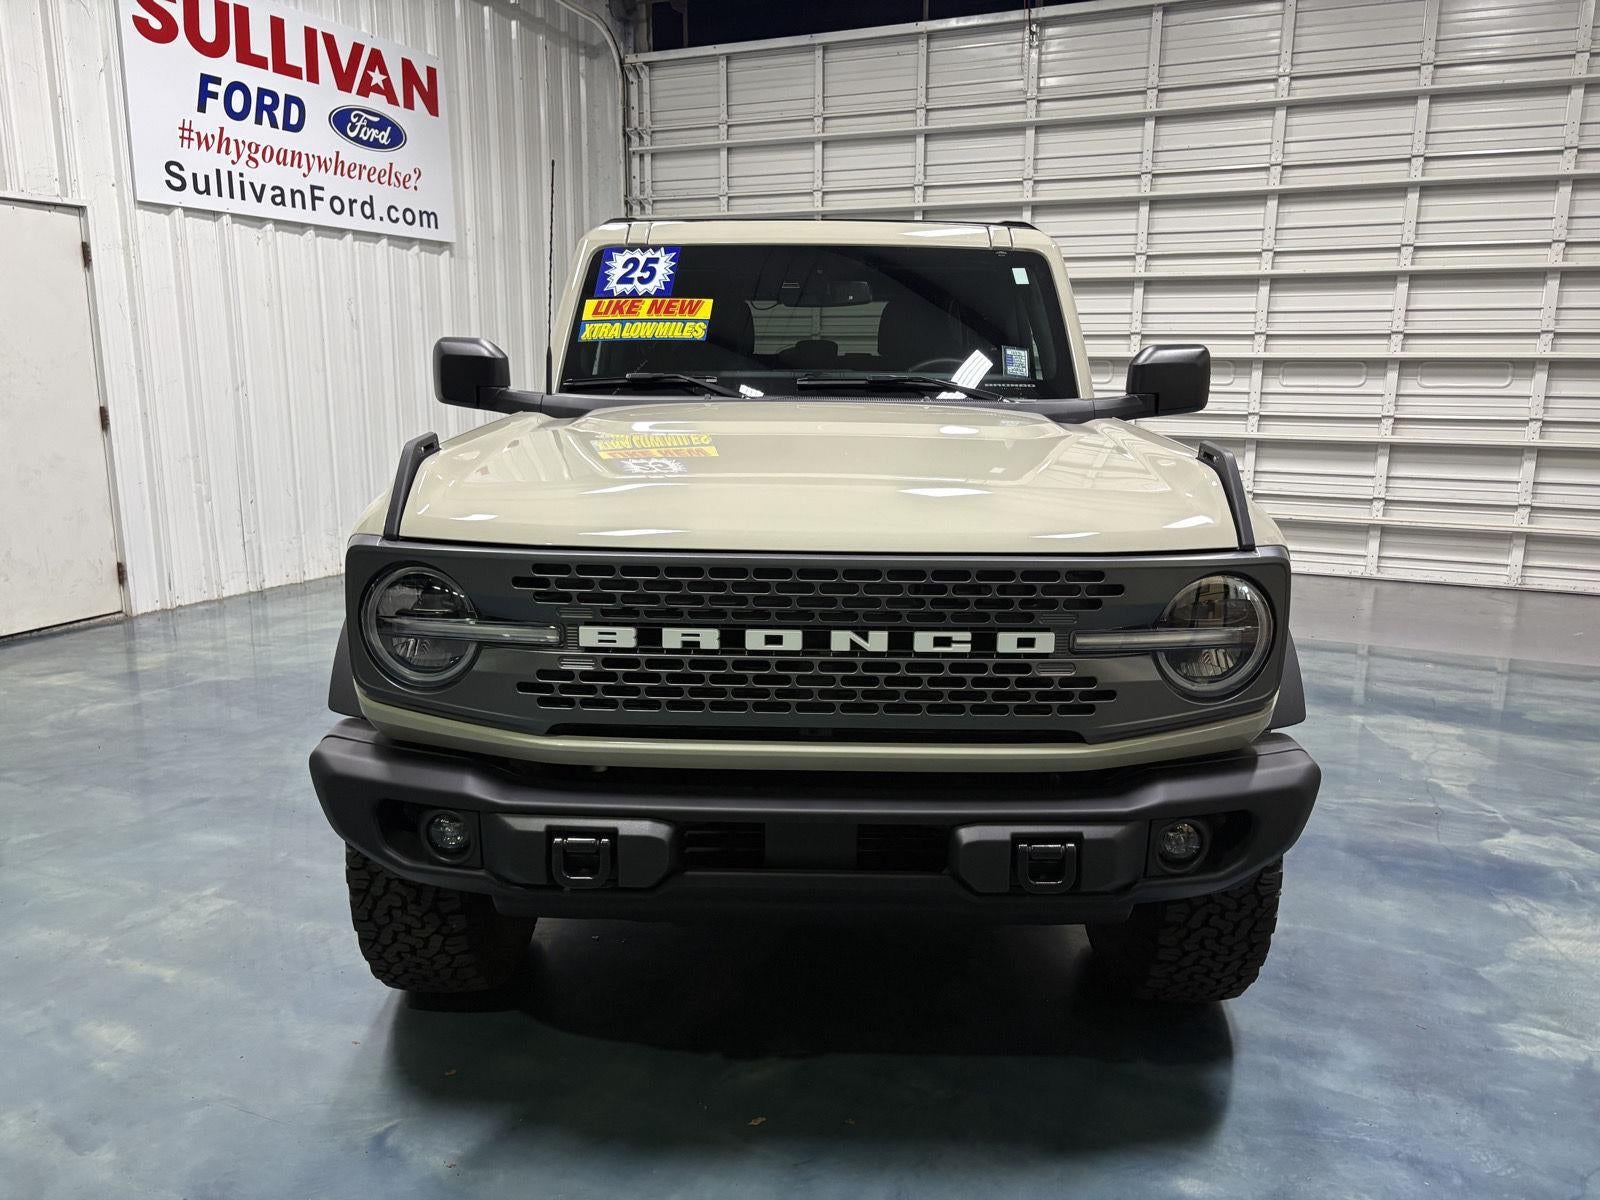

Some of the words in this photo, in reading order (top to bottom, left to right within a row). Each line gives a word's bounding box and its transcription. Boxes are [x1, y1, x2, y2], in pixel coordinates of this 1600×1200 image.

[132, 0, 439, 118] SULLIVAN
[197, 72, 306, 134] FORD
[347, 111, 391, 145] Ford
[178, 119, 422, 191] #whygoanywhereelse?
[164, 160, 439, 230] SullivanFord.com
[616, 257, 660, 285] 25
[592, 299, 644, 317] LIKE
[647, 299, 704, 317] NEW
[581, 322, 622, 341] XTRA
[578, 625, 1056, 654] BRONCO
